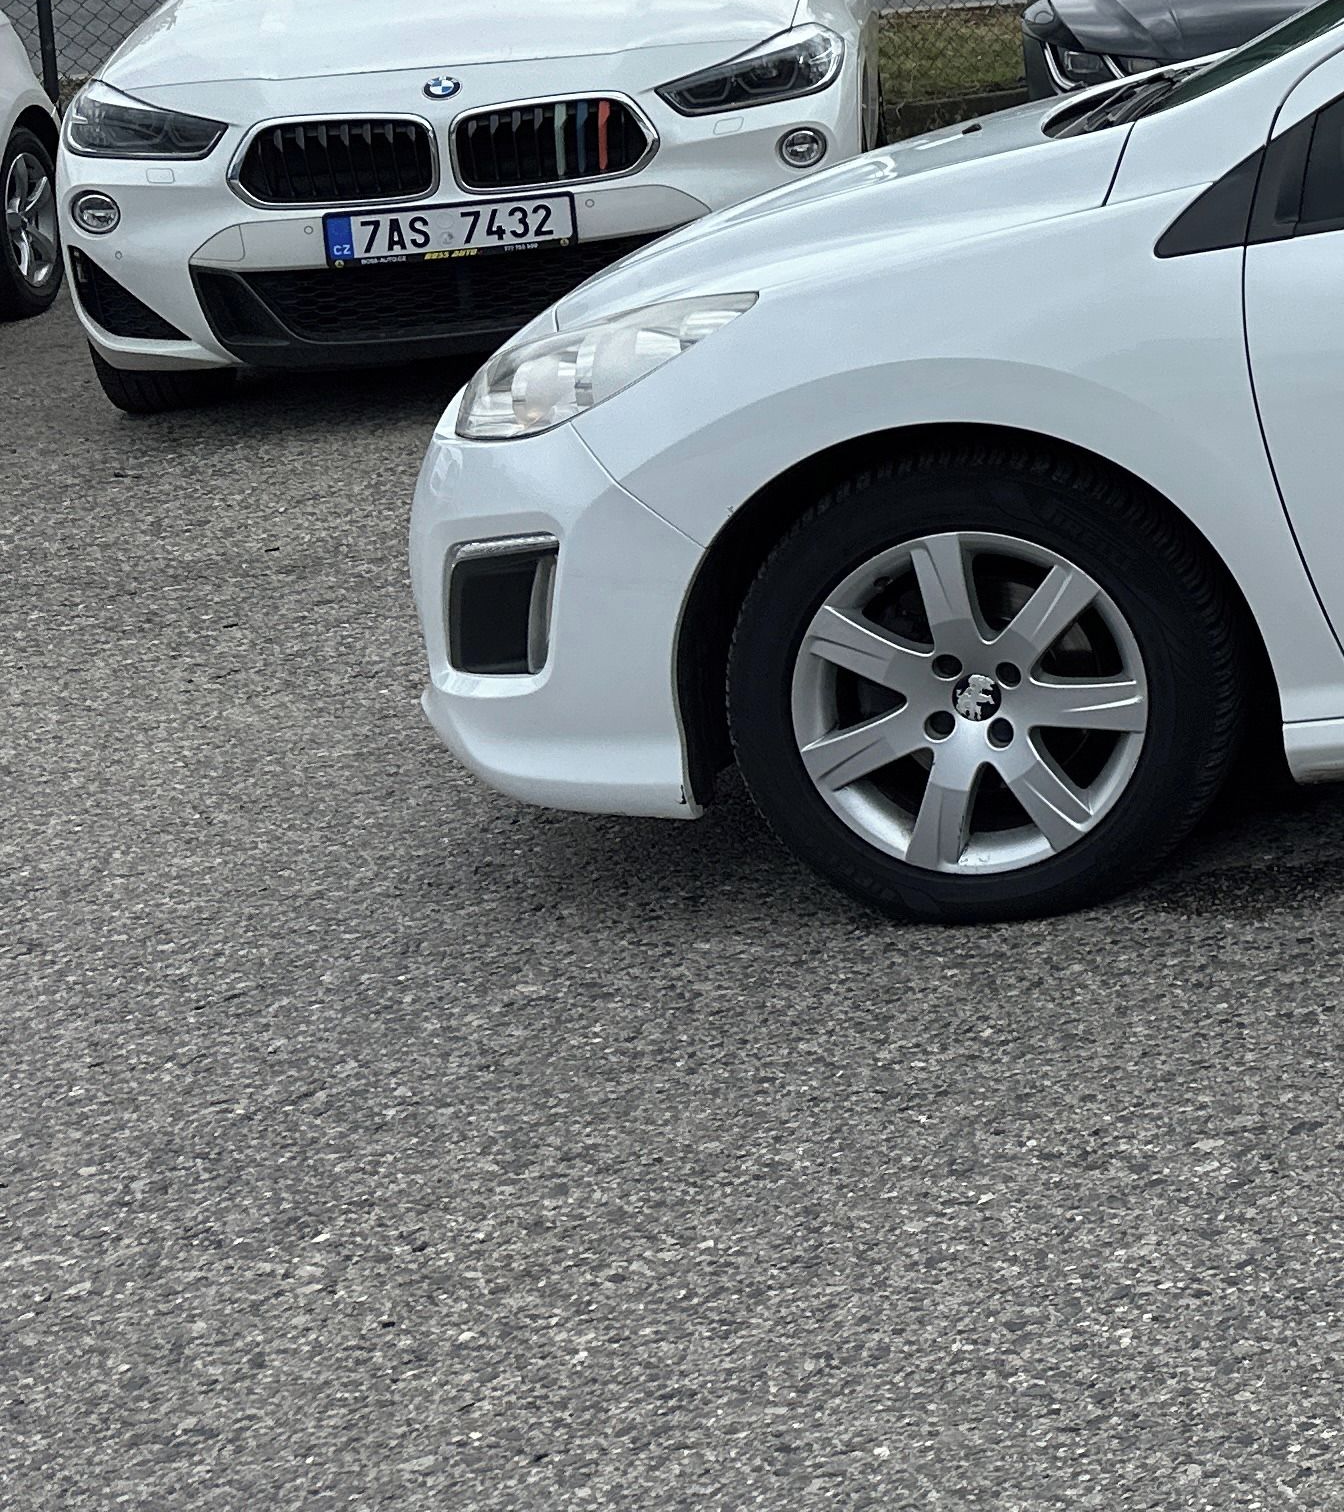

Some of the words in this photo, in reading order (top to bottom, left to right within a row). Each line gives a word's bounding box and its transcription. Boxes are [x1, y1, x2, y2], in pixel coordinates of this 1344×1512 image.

[360, 216, 430, 254] 7AS
[460, 204, 554, 245] 7432
[333, 244, 351, 256] CZ
